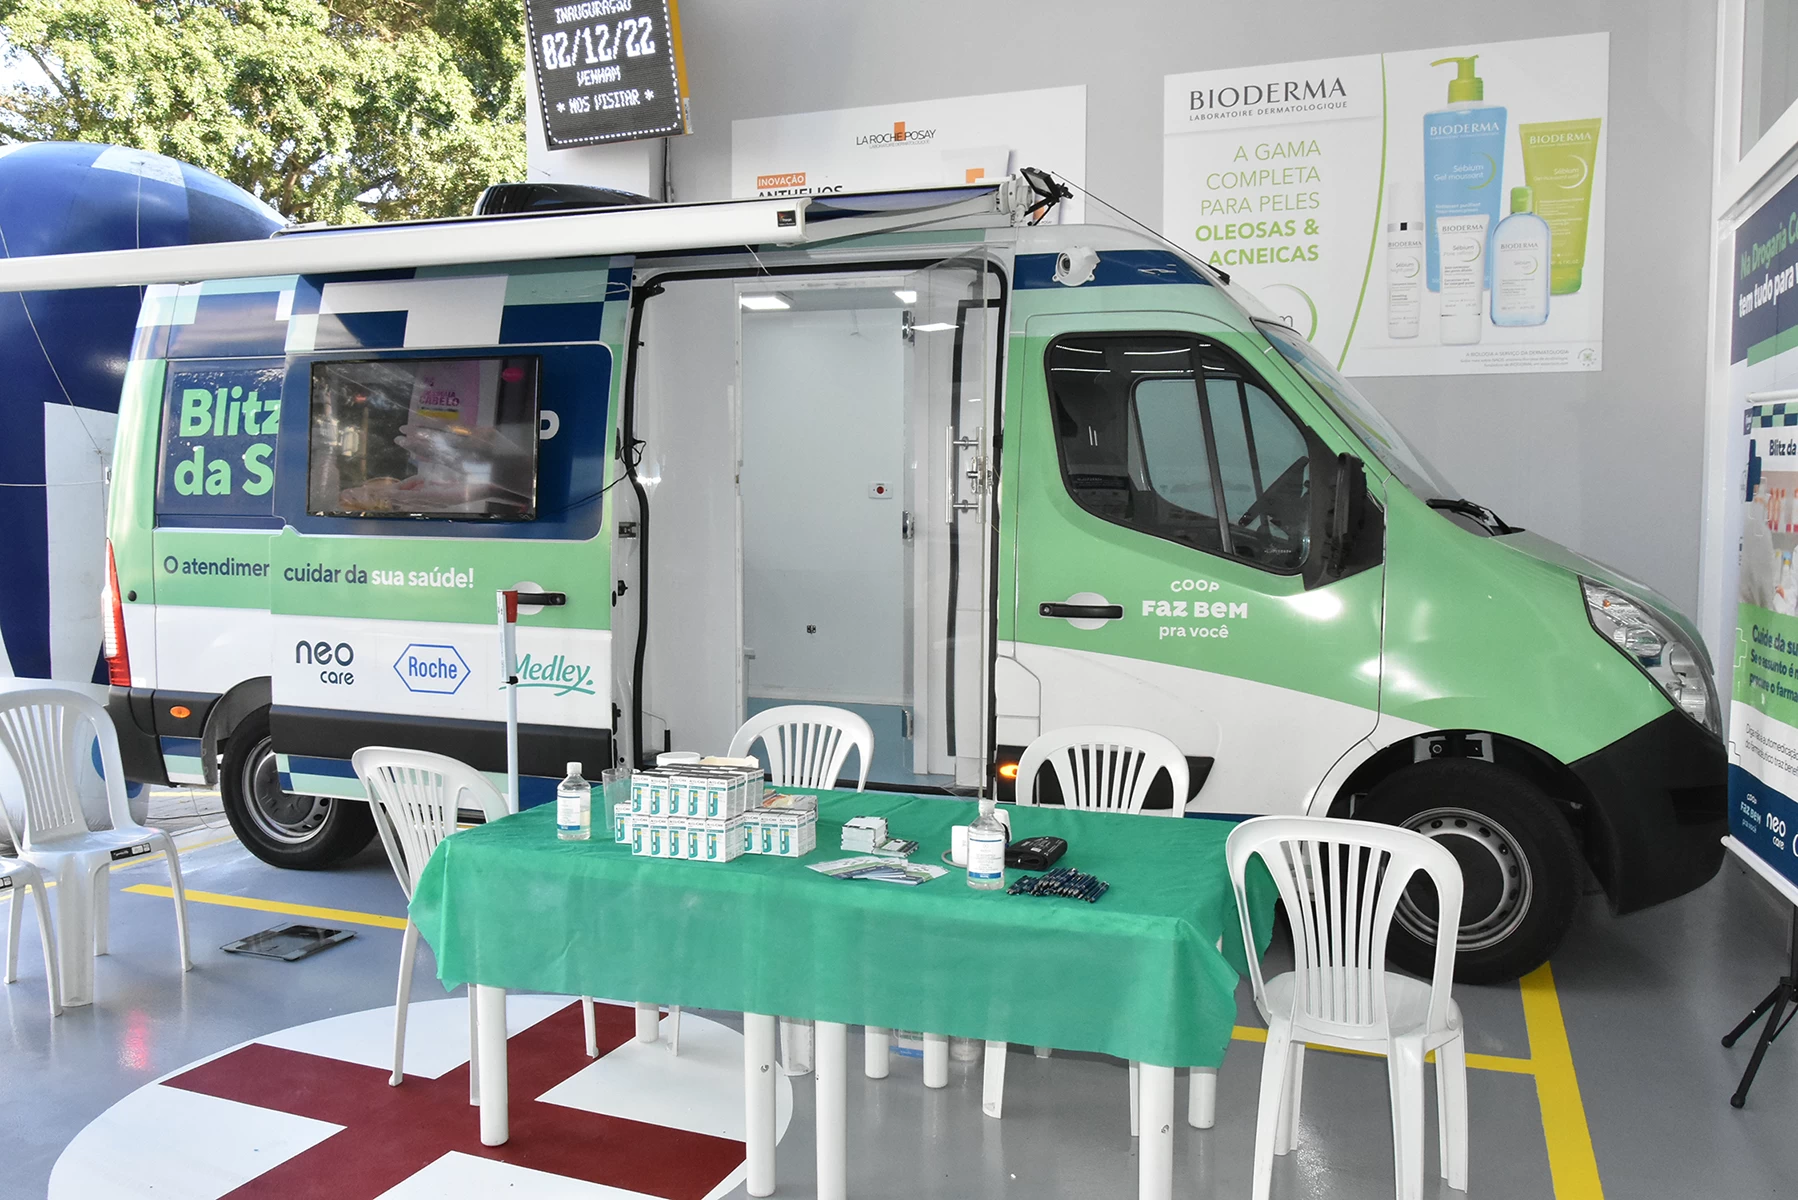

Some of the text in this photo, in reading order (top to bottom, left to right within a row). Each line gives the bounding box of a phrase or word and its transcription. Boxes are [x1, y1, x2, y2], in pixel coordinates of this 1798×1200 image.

[542, 16, 656, 70] 02/12/22
[577, 65, 621, 87] VENHAM
[568, 89, 641, 114] NOS VISITAR
[1190, 77, 1347, 110] BIODERMA
[1190, 101, 1347, 121] LABORATOIRE DERMATOLOGIQUE
[1430, 122, 1500, 136] BIODERMA
[1530, 132, 1592, 145] BIODERMA
[856, 136, 869, 145] LA
[1233, 140, 1321, 162] A GAMA
[758, 174, 804, 187] INOVAÇÃO
[1206, 166, 1321, 190] COMPLETA
[1201, 192, 1320, 216] PARA PELES
[1195, 218, 1320, 241] OLEOSAS &
[1442, 224, 1484, 232] BIODERMA
[1208, 244, 1319, 266] ACNEICAS
[1740, 250, 1751, 280] Na
[1752, 222, 1787, 272] Drogaria
[1739, 292, 1753, 318] tem
[1754, 273, 1773, 309] tudo
[1773, 265, 1794, 306] para
[180, 386, 281, 437] Blitz
[1769, 438, 1797, 456] Blitz da
[173, 445, 232, 496] da
[164, 555, 178, 574] O
[283, 563, 475, 589] cuidar da sua saúde!
[1170, 579, 1220, 593] COOP
[1159, 624, 1229, 640] pra você
[1752, 624, 1773, 648] Cuide
[1774, 633, 1786, 653] da
[295, 640, 354, 667] neo
[319, 669, 355, 685] care
[408, 656, 458, 680] Roche
[1762, 657, 1787, 676] assunto
[1788, 663, 1794, 678] é
[1770, 683, 1775, 694] o
[1766, 812, 1786, 838] neo
